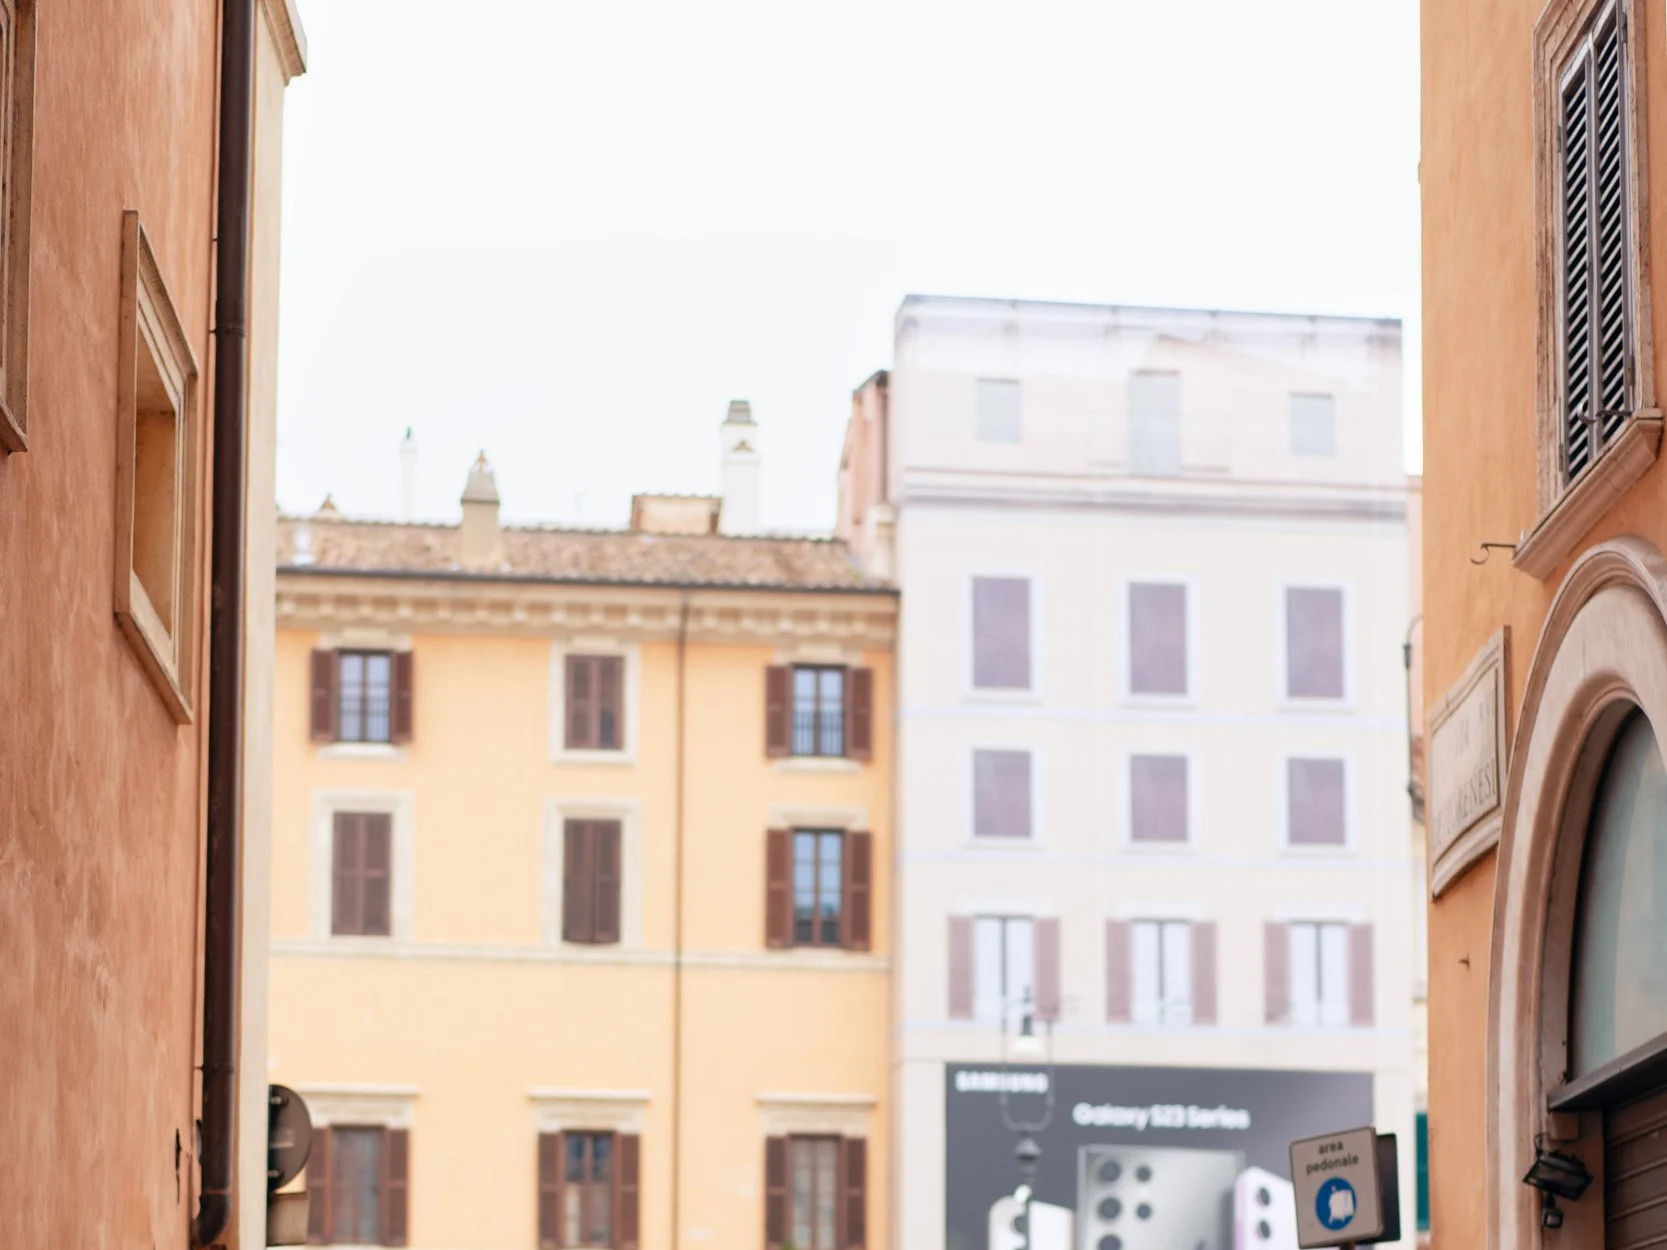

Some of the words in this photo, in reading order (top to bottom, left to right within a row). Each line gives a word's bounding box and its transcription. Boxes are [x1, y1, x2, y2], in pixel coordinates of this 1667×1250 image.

[1072, 1102, 1149, 1131] Galaxy
[1150, 1104, 1186, 1128] S23
[1187, 1104, 1251, 1129] Series
[1318, 1140, 1343, 1155] area
[1306, 1153, 1359, 1175] pedonale
